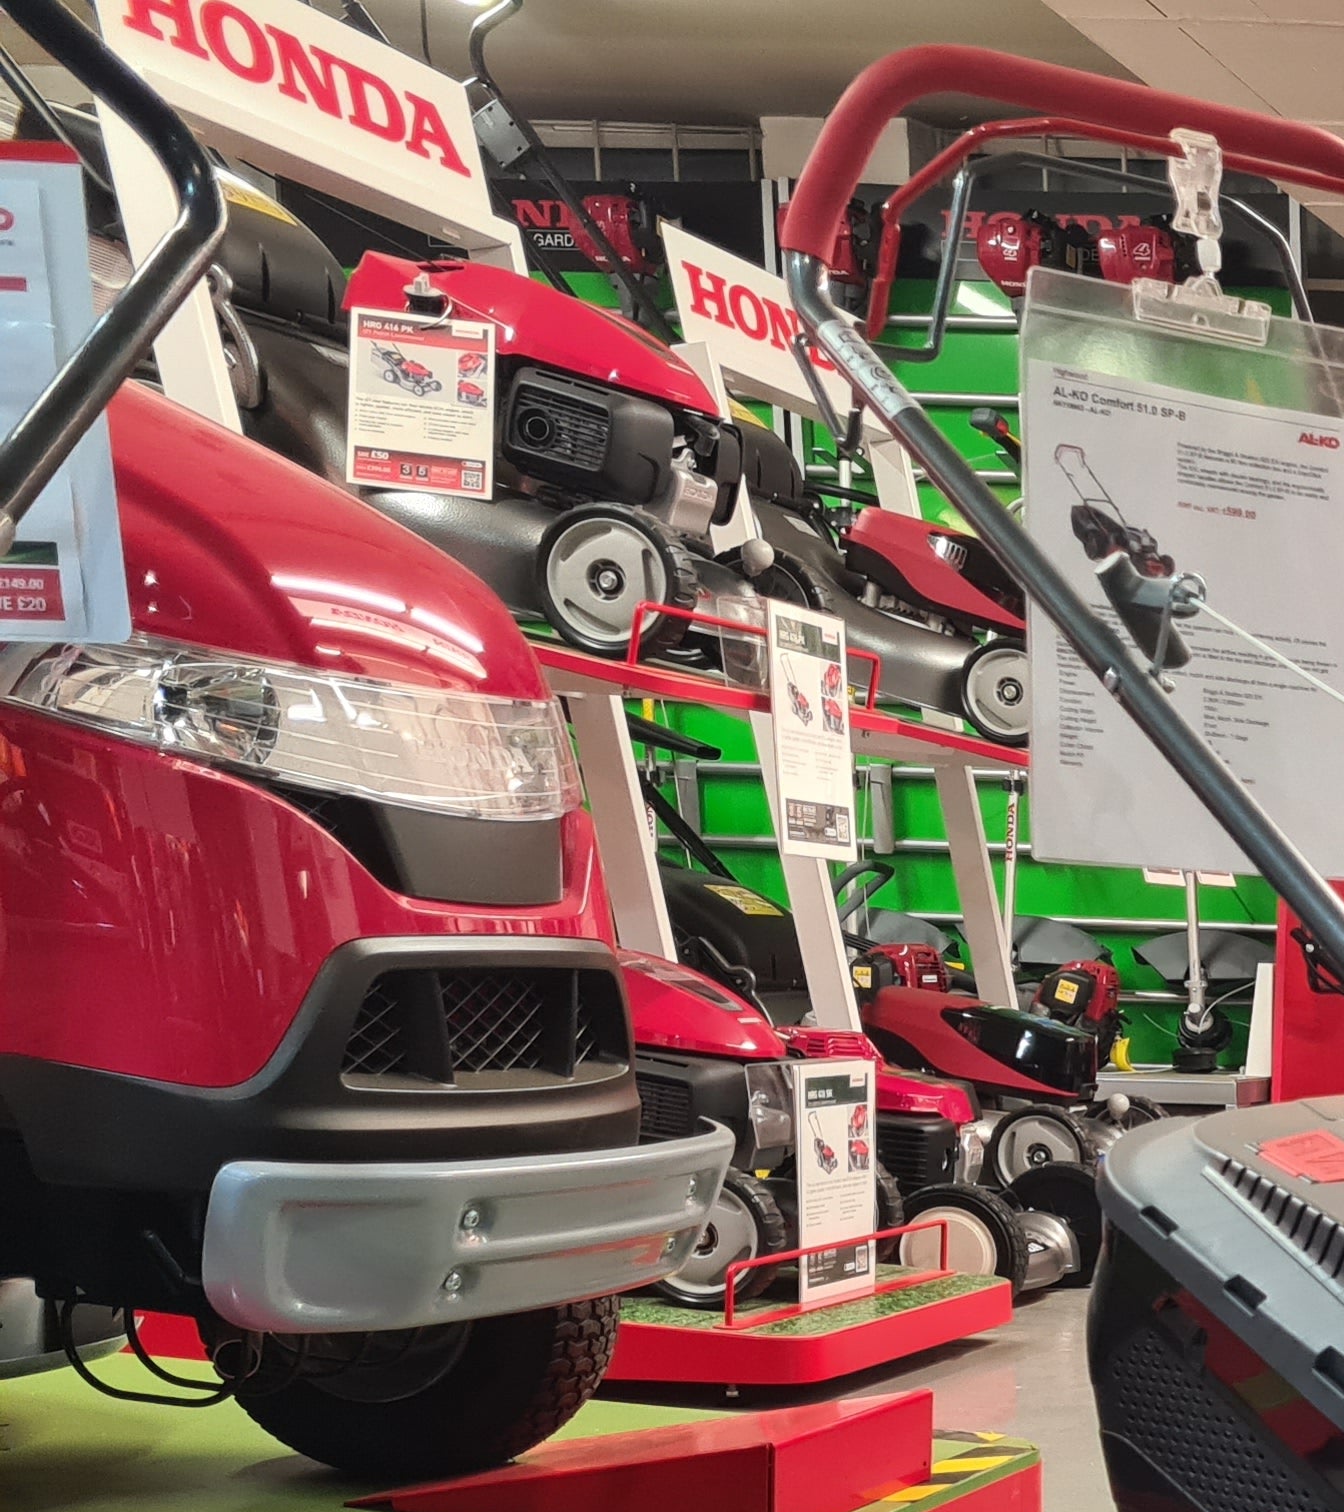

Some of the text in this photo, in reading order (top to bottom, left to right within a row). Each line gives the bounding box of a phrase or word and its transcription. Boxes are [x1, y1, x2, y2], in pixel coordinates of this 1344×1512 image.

[123, 0, 472, 178] HONDA
[401, 325, 414, 334] PK
[1053, 386, 1089, 402] AL-KO
[1091, 393, 1134, 412] Comfort
[1137, 402, 1158, 416] 51.0
[1160, 407, 1187, 421] SP-B
[1298, 432, 1340, 449] AL-KO
[370, 450, 390, 460] £50
[1006, 803, 1015, 861] HONDA
